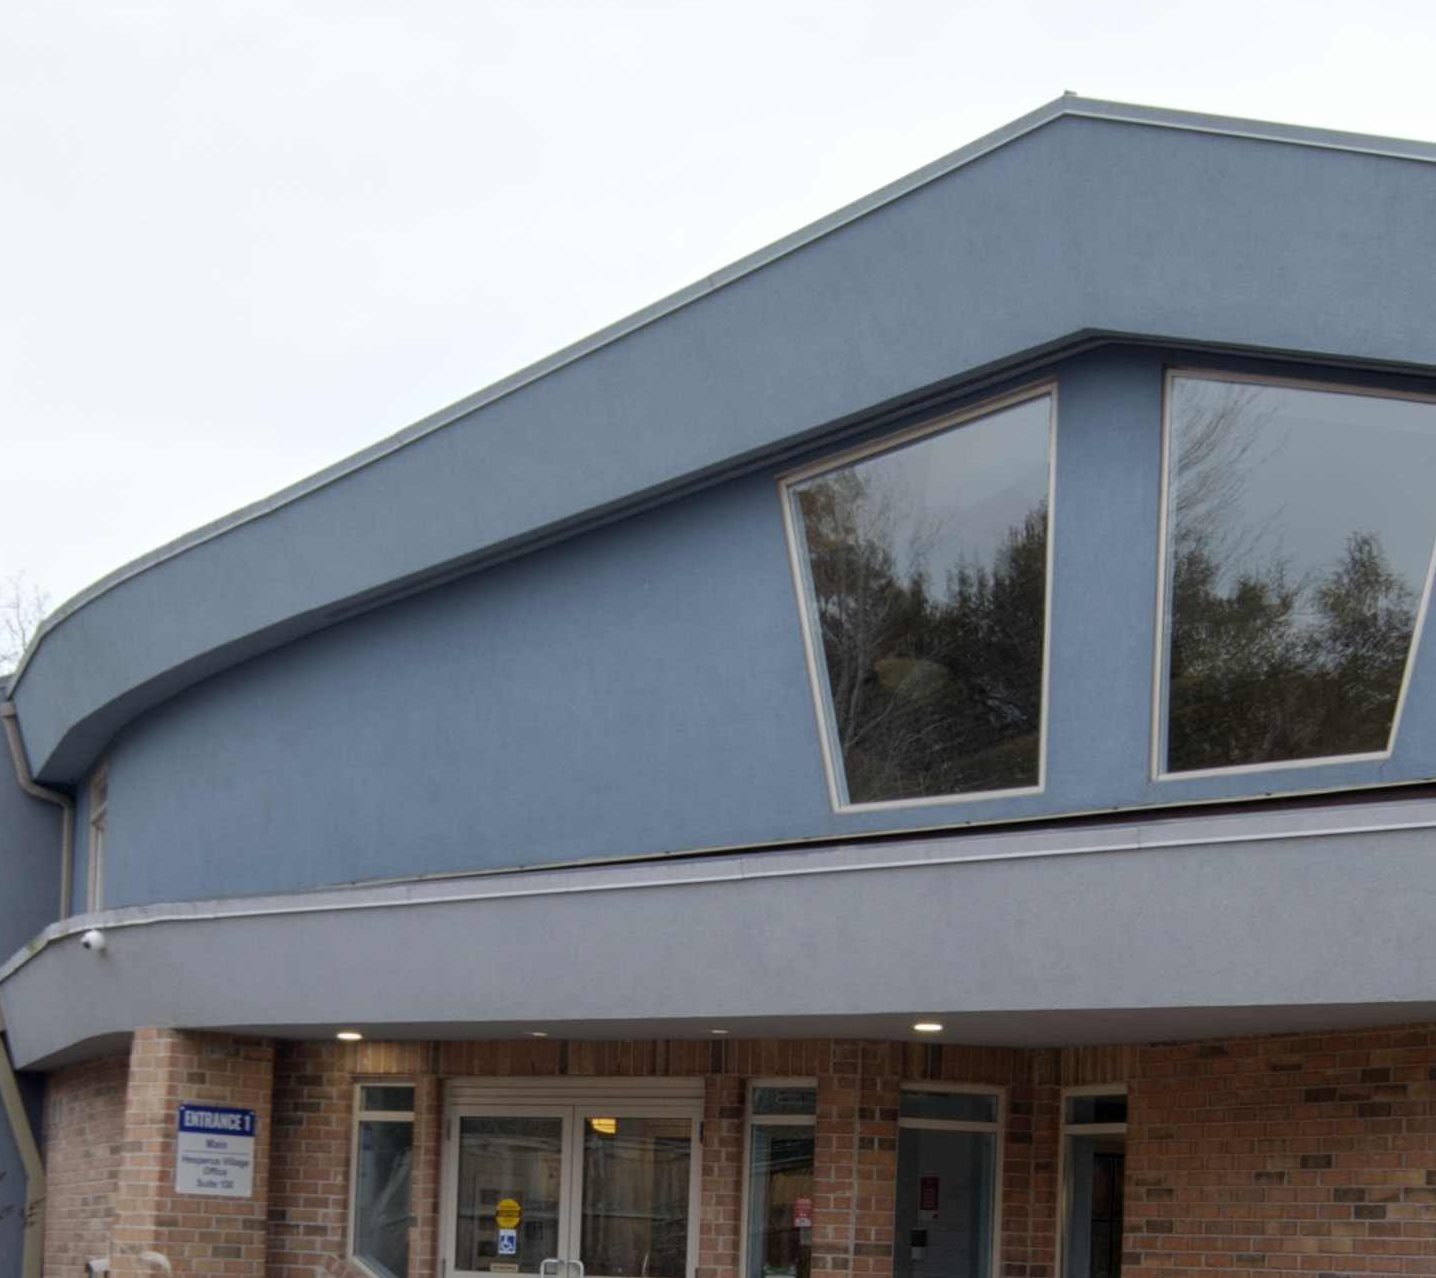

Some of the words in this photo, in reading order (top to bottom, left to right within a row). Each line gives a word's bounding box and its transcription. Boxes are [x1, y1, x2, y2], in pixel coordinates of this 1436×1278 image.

[184, 1110, 242, 1131] ENTRANCE
[244, 1115, 251, 1131] 1
[206, 1139, 228, 1149] Main
[204, 1166, 228, 1176] Office
[197, 1178, 218, 1188] Suite
